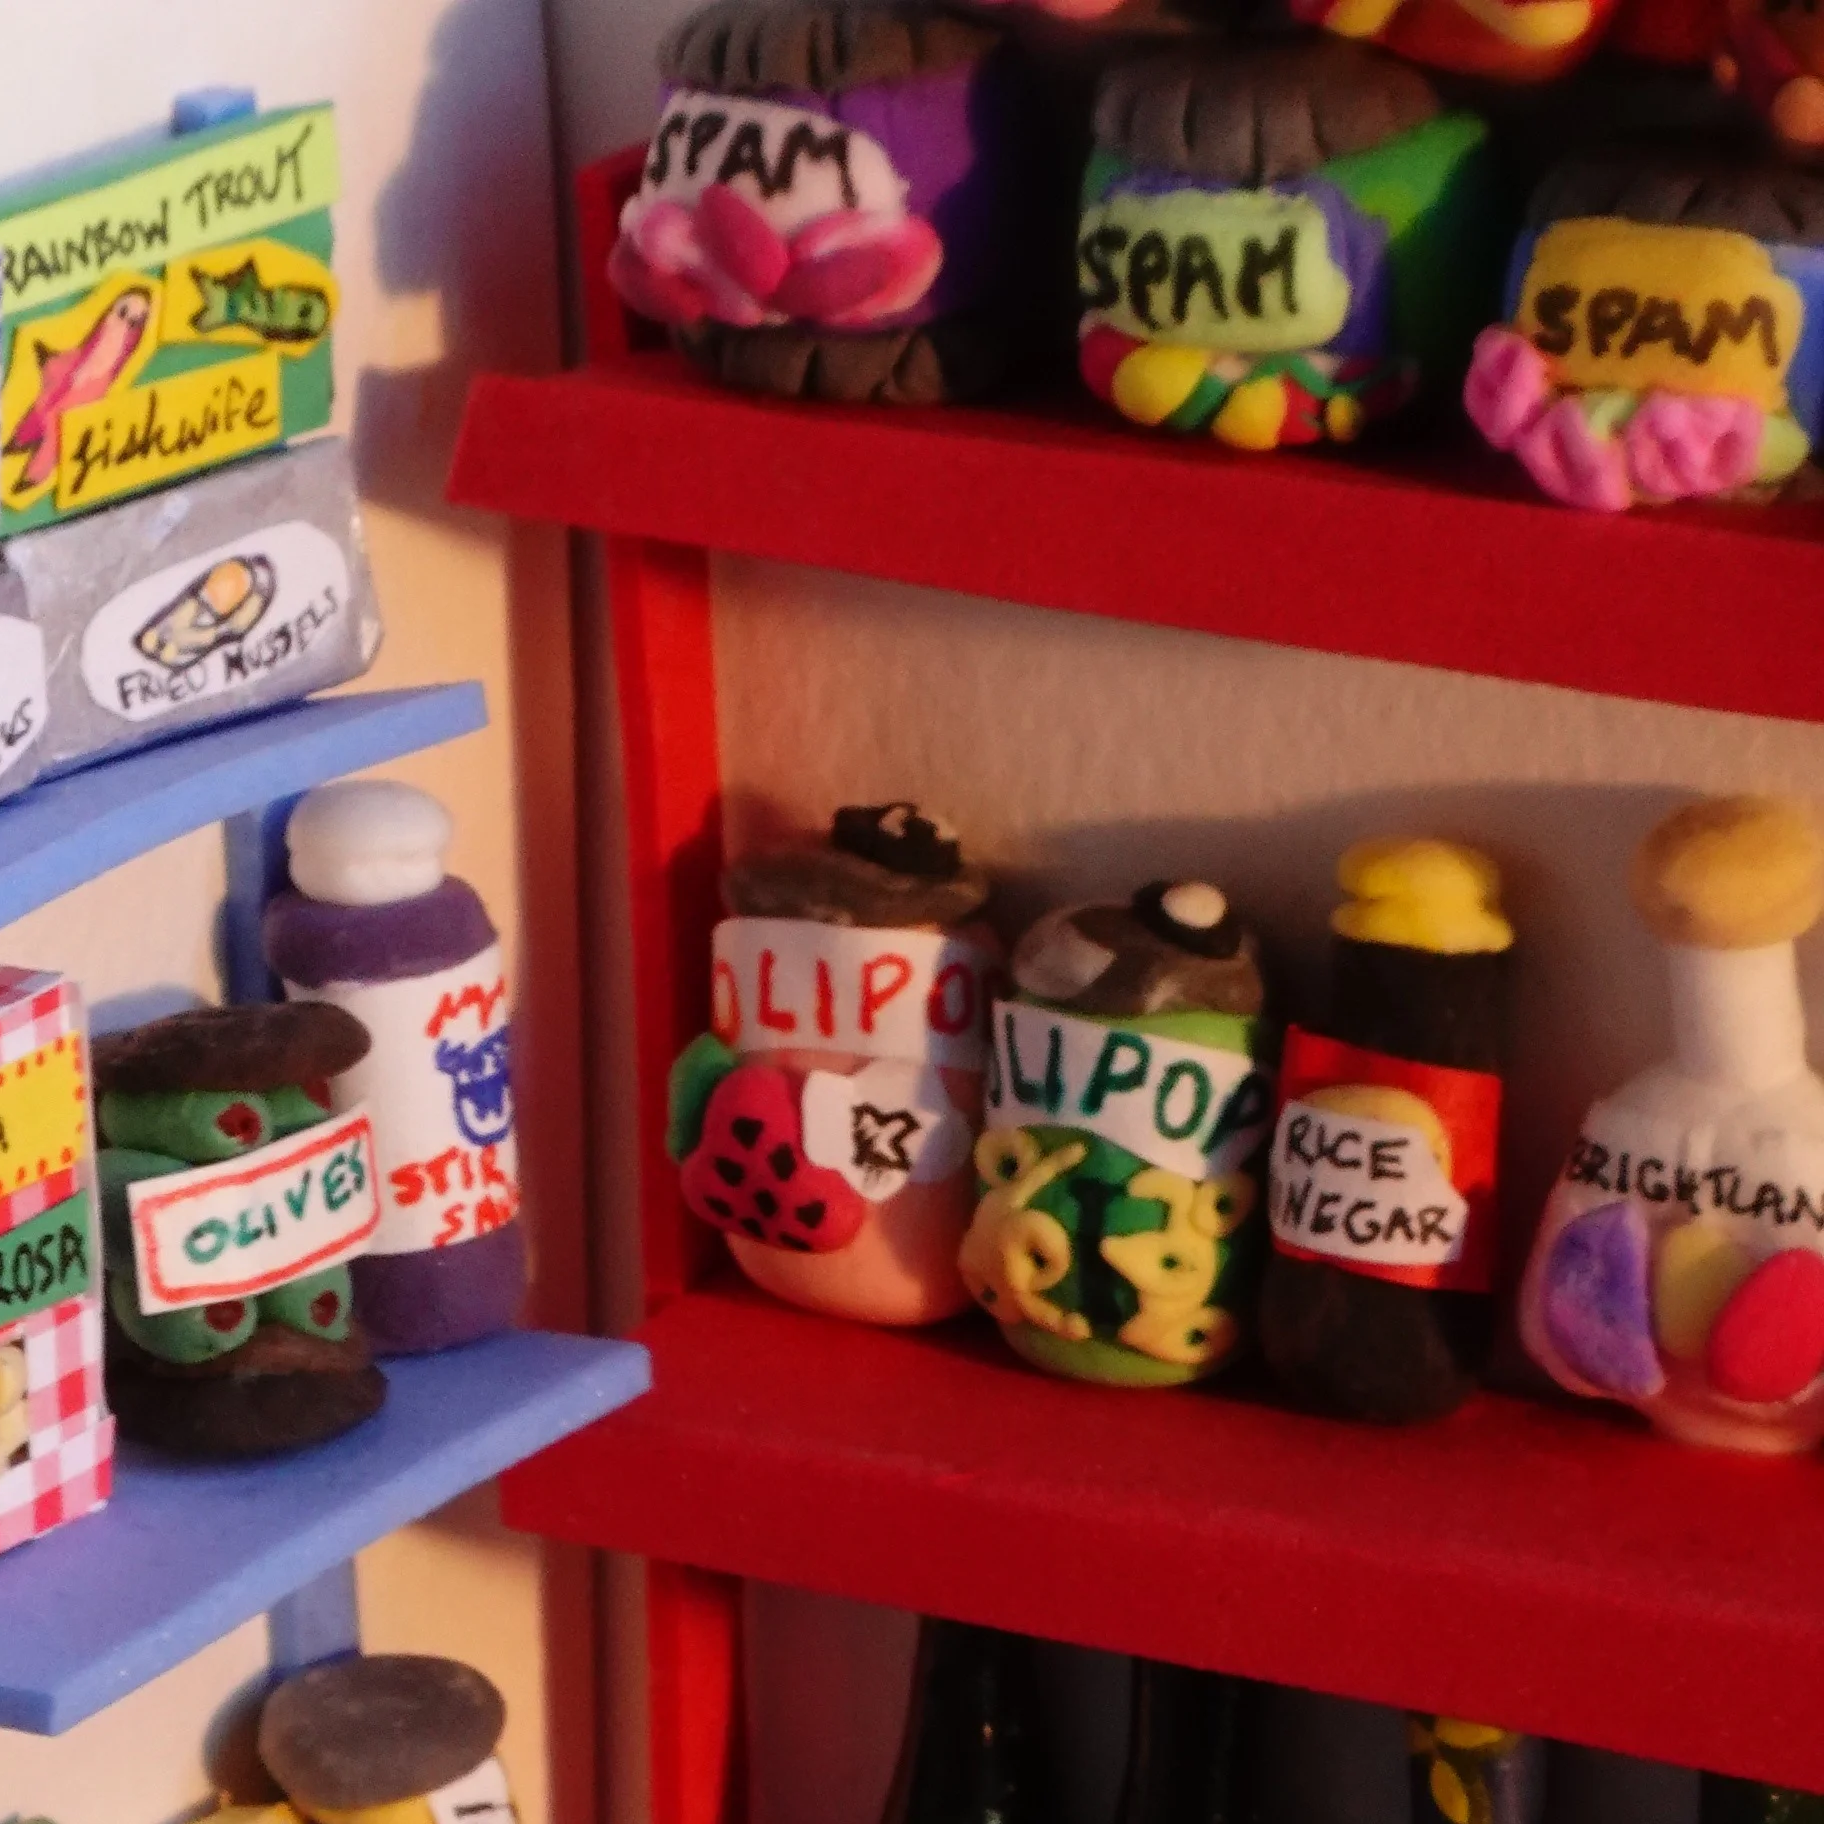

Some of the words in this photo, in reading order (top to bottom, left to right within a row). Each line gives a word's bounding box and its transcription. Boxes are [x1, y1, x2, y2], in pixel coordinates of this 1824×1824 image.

[4, 198, 169, 295] RAINBOW
[183, 122, 314, 229] TROUT
[648, 112, 858, 208] SPAM
[1074, 225, 1298, 331] SPAM
[1533, 285, 1780, 367] SPAM
[1286, 1115, 1409, 1180] RICE
[184, 1134, 366, 1264] OLIVES
